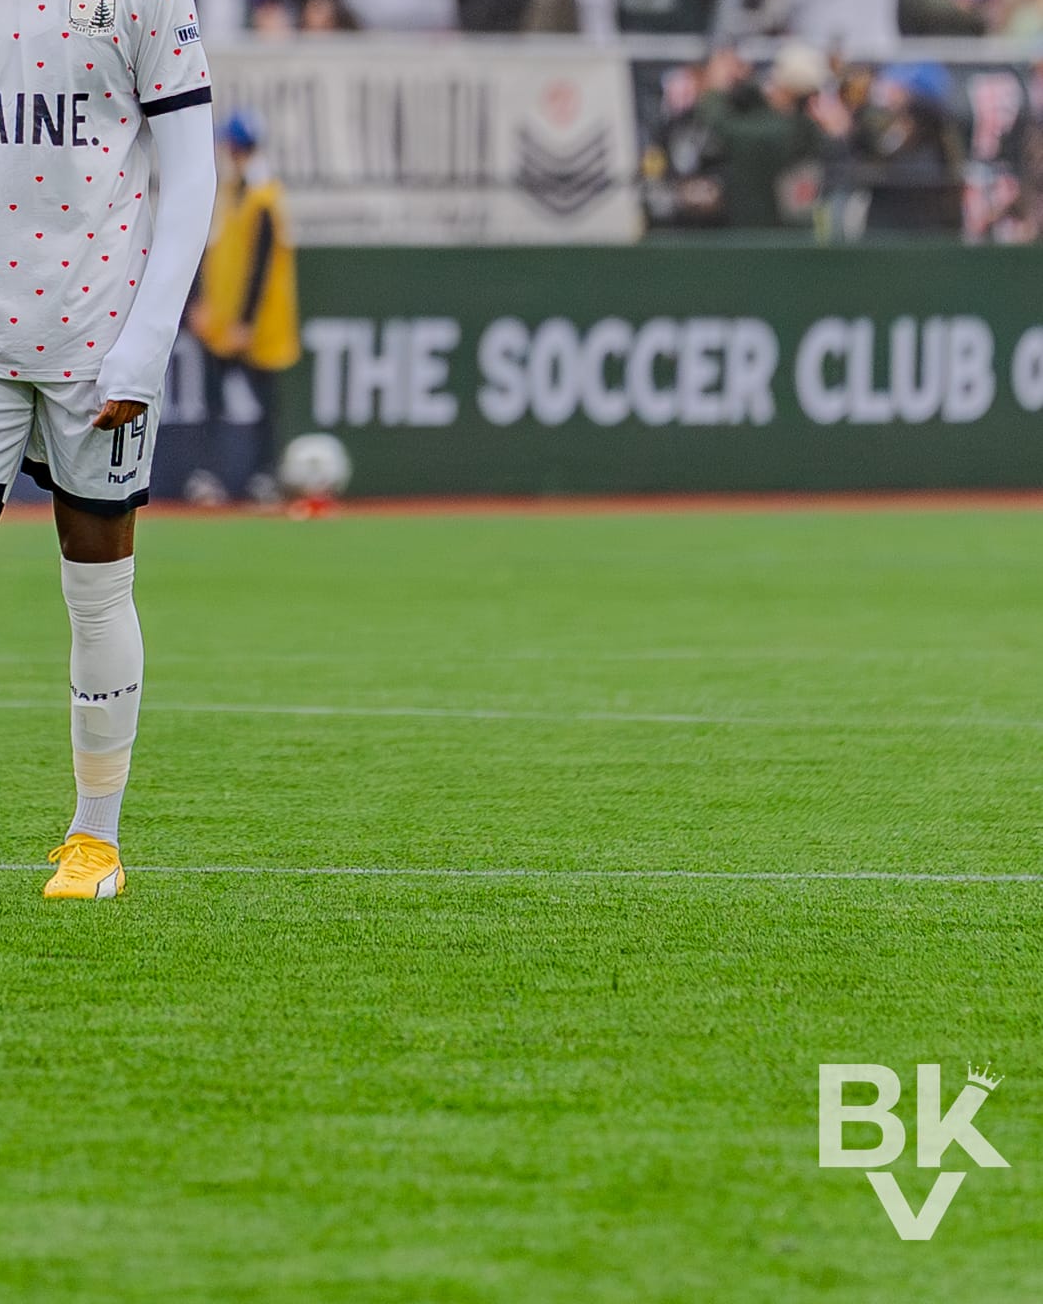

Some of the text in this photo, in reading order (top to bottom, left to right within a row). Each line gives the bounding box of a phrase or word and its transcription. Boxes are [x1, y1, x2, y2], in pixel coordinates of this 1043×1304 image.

[303, 316, 459, 427] THE
[477, 316, 779, 427] SOCCER
[795, 314, 996, 423] CLUB
